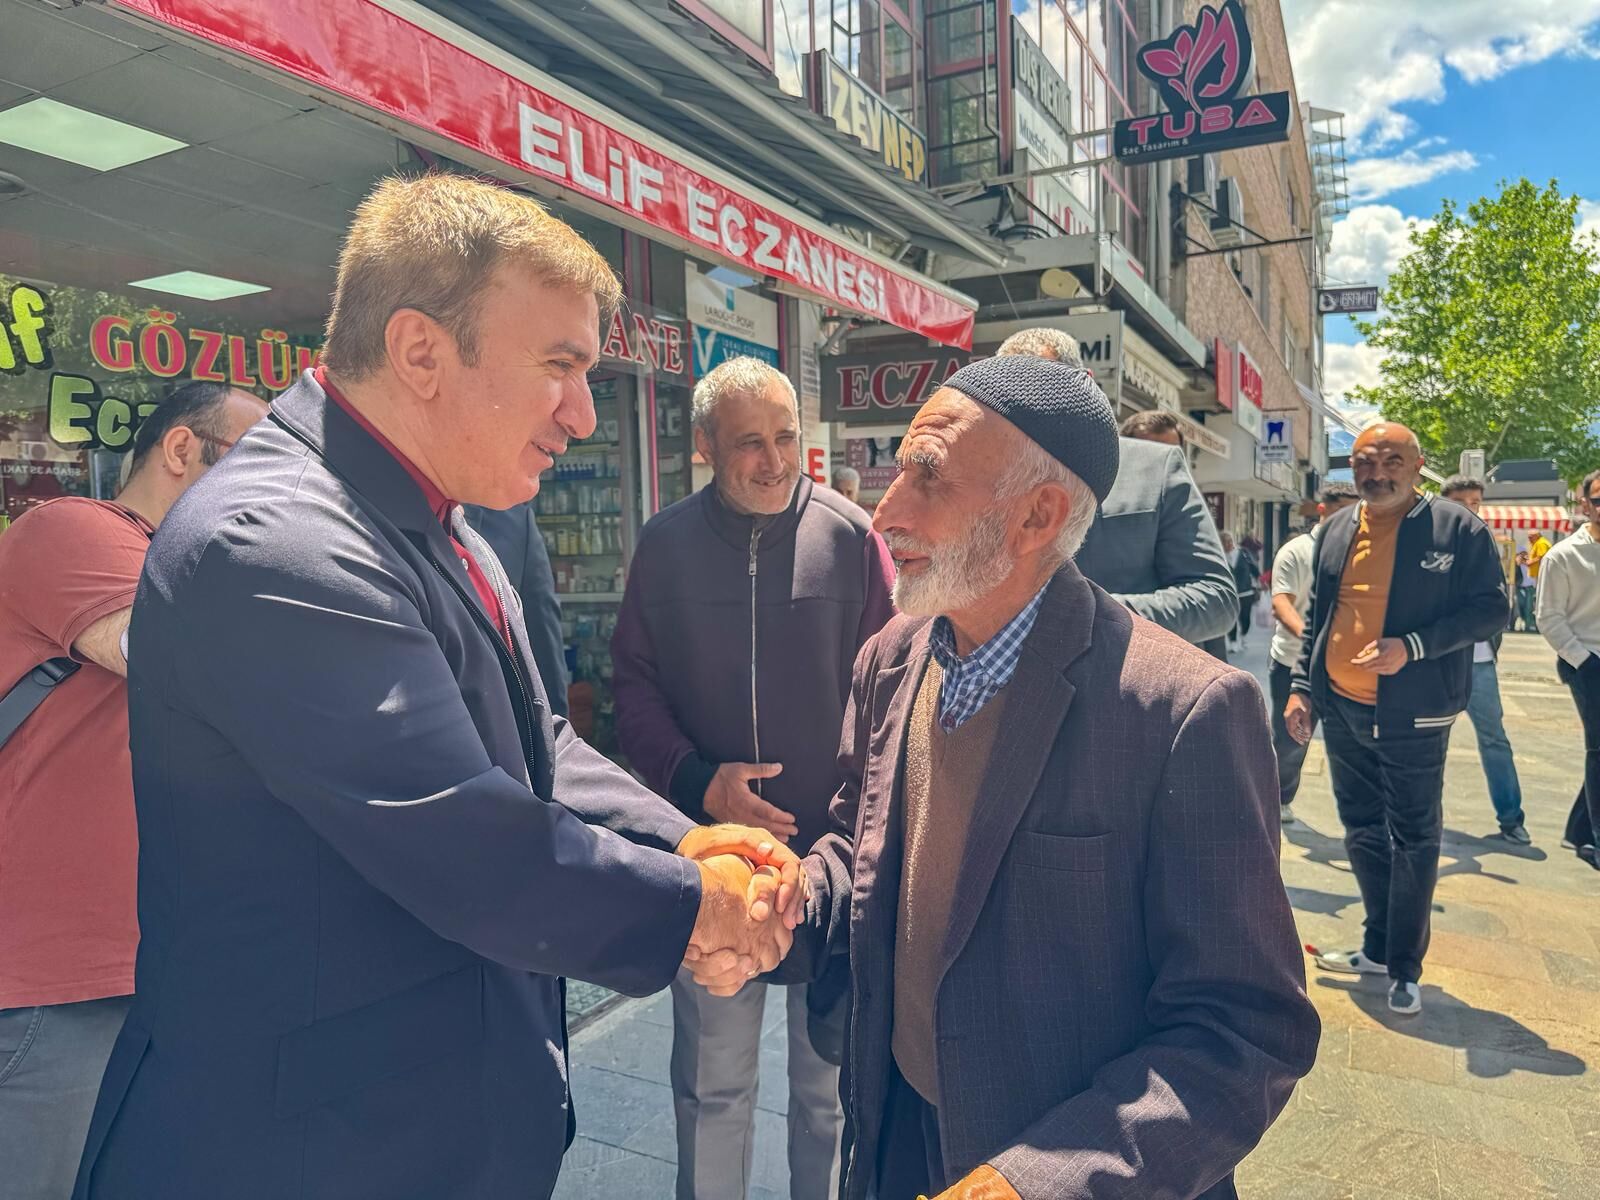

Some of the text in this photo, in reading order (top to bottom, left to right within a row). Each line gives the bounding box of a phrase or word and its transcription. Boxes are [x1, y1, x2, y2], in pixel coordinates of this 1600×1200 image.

[831, 71, 925, 182] ZEYNEP
[1128, 99, 1277, 145] TUBA
[0, 287, 45, 369] f
